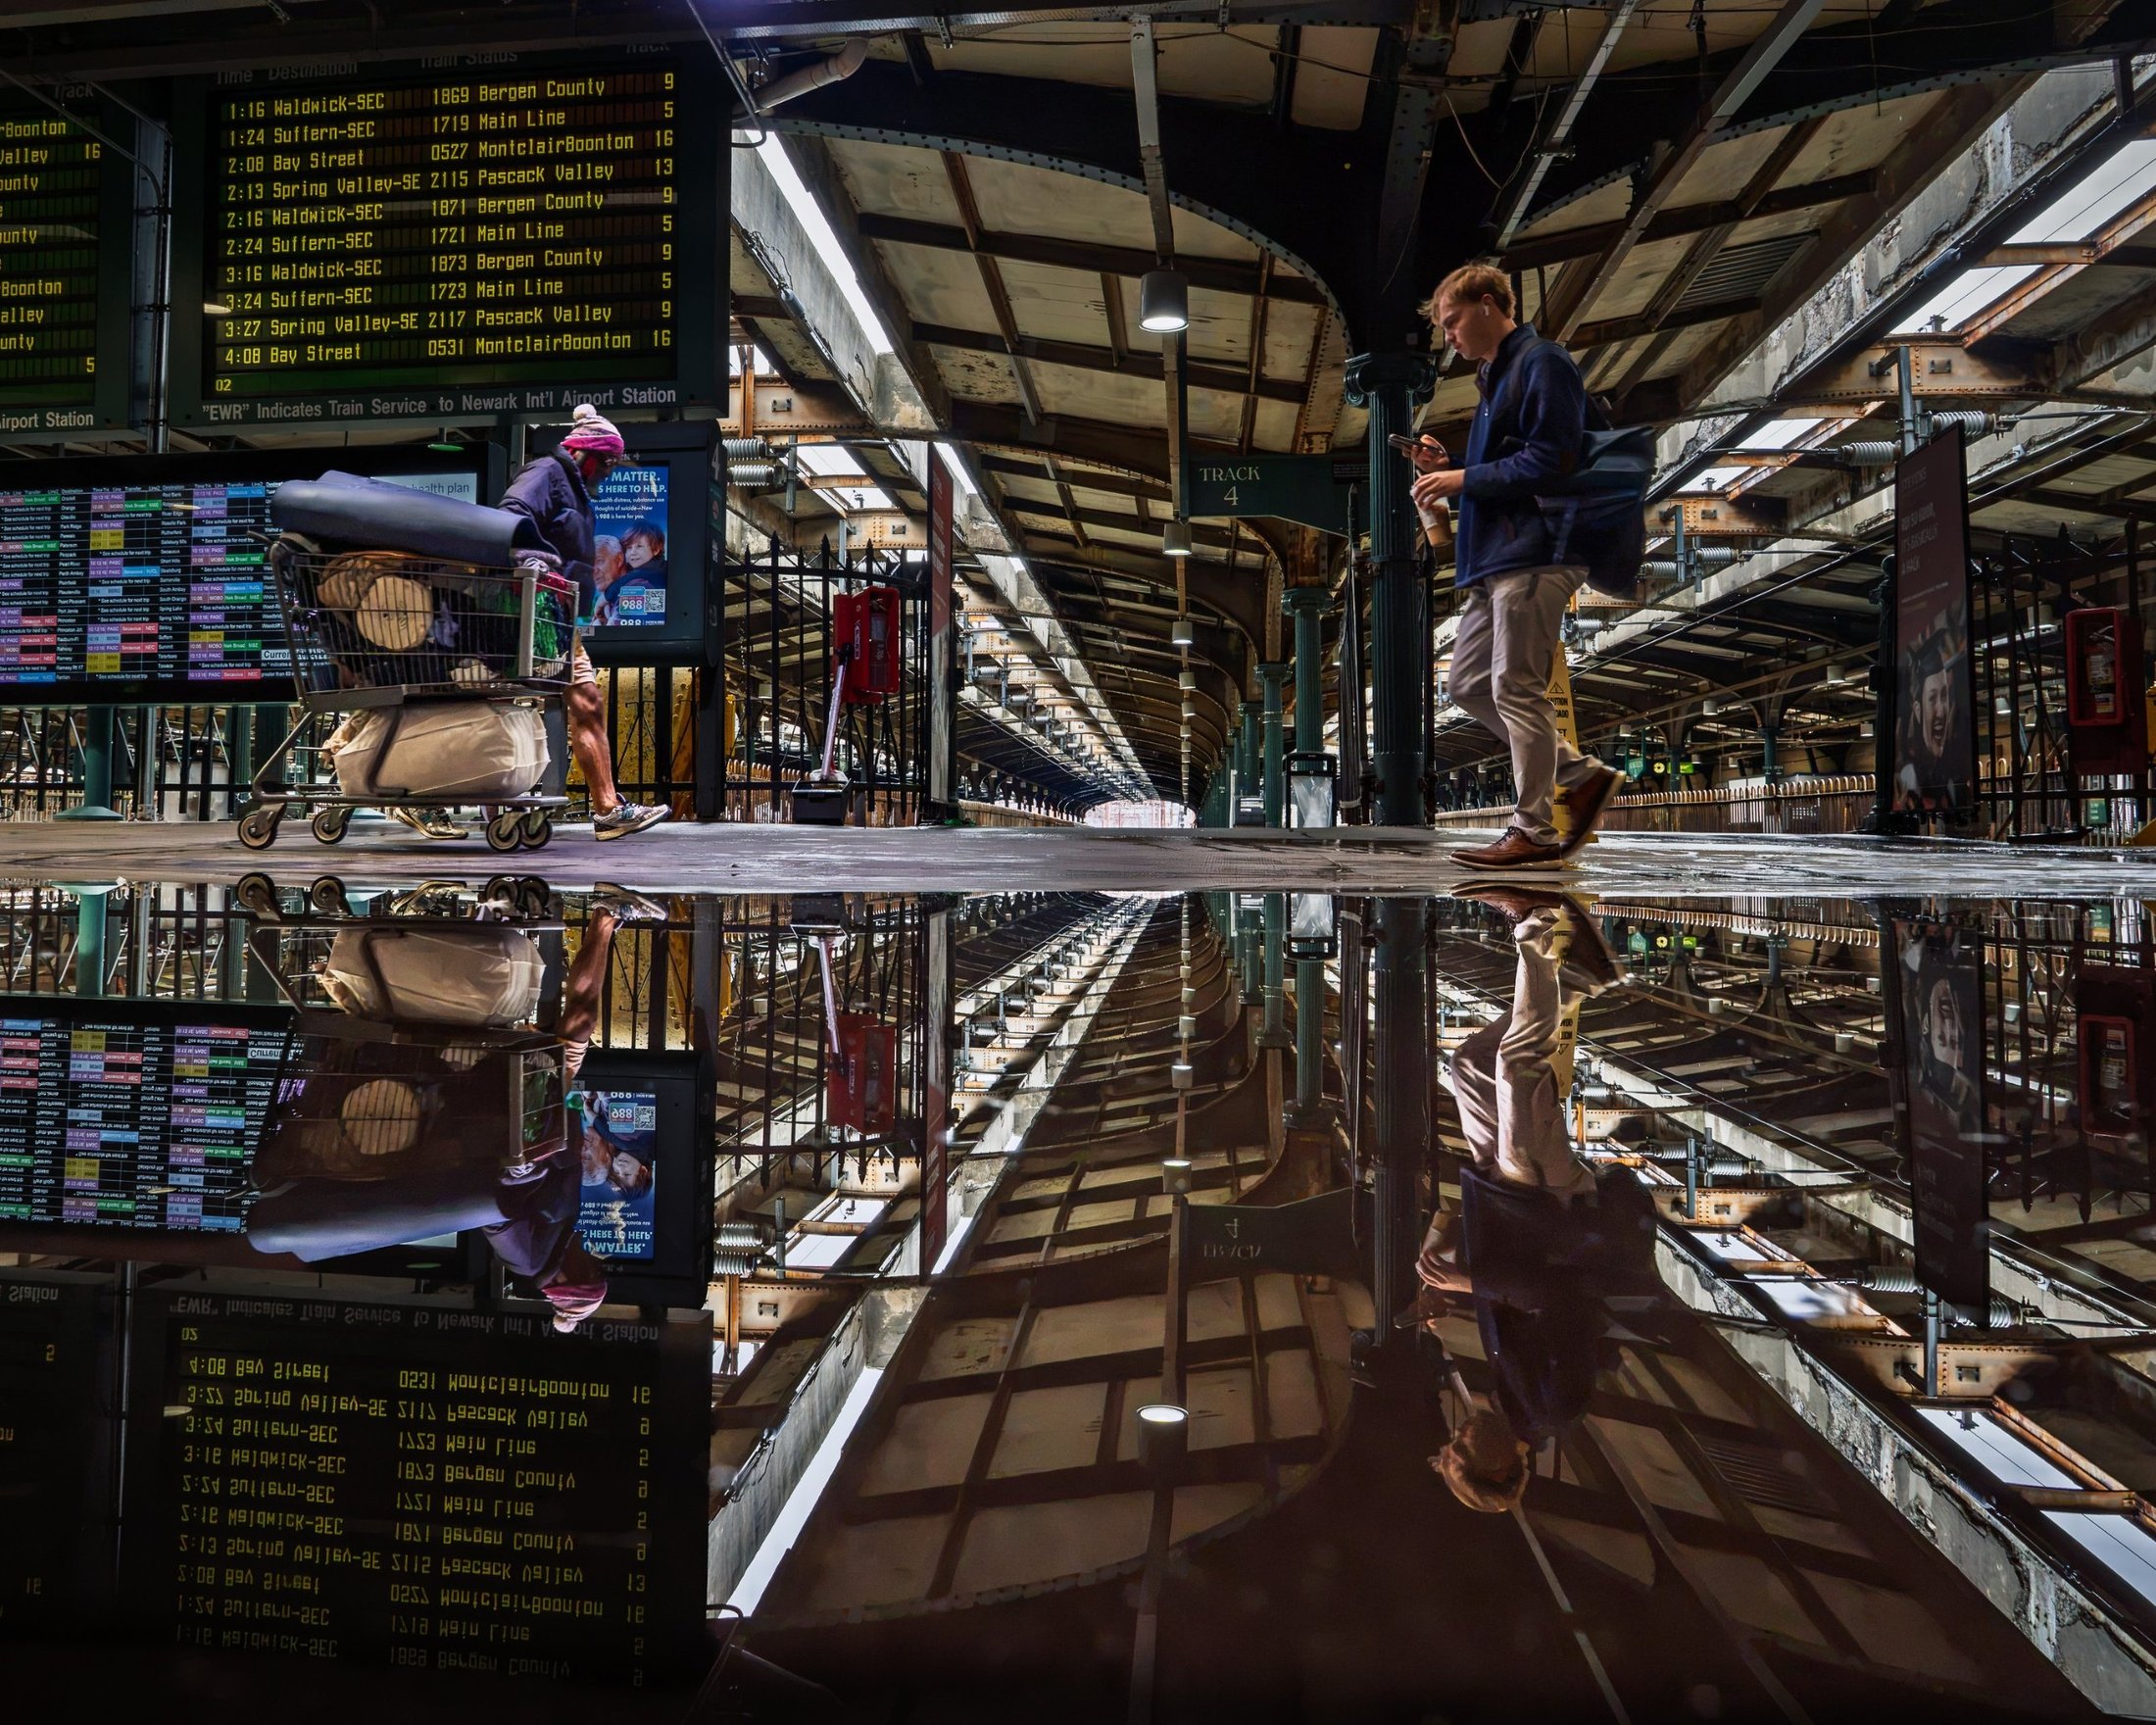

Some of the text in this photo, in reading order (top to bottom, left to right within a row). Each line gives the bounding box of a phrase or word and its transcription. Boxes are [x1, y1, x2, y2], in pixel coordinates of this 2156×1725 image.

[231, 74, 674, 120] 1:16 Waldwick-SEC 1869 Bergen County 9
[230, 102, 674, 146] 1:24 Suffern-SEC 1719 Main Line 5
[84, 143, 101, 159] 16
[228, 130, 673, 173] 2:08 Bay Street 0527 MontclairBoonton 16
[227, 159, 673, 201] 2:13 Spring Valley-SE 2115 Pascack Valley 13
[227, 187, 673, 228] 2:16 Waldwick-SEC 1871 Bergen County 9
[226, 216, 672, 256] 2:24 Suffern-SEC 1721 Main Line 5
[226, 244, 672, 283] 3:16 Waldwick-SEC 1873 Bergen County 9
[225, 272, 671, 311] 3:24 Suffern-SEC 1723 Main Line 5
[224, 301, 671, 338] 3:27 Spring Valley-SE 2117 Pascack Valley 9
[224, 330, 671, 366] 4:08 Bay Street 0531 MontclairBoonton 16
[86, 357, 95, 372] 5
[86, 357, 95, 372] 5
[216, 378, 232, 392] 02
[257, 402, 322, 419] Indicates
[328, 398, 364, 416] Train
[371, 397, 427, 415] Service
[439, 396, 454, 412] to
[462, 392, 517, 411] Newark
[563, 389, 614, 407] Airport
[622, 387, 676, 404] Station
[0, 411, 94, 431] irport Station
[710, 442, 720, 481] 4
[1199, 466, 1261, 482] TRACK
[447, 482, 469, 495] plan
[612, 470, 661, 482] MATTER.
[643, 484, 667, 494] HELP.
[1223, 485, 1240, 506] 4
[622, 600, 643, 610] 988
[1546, 697, 1569, 706] AUTION
